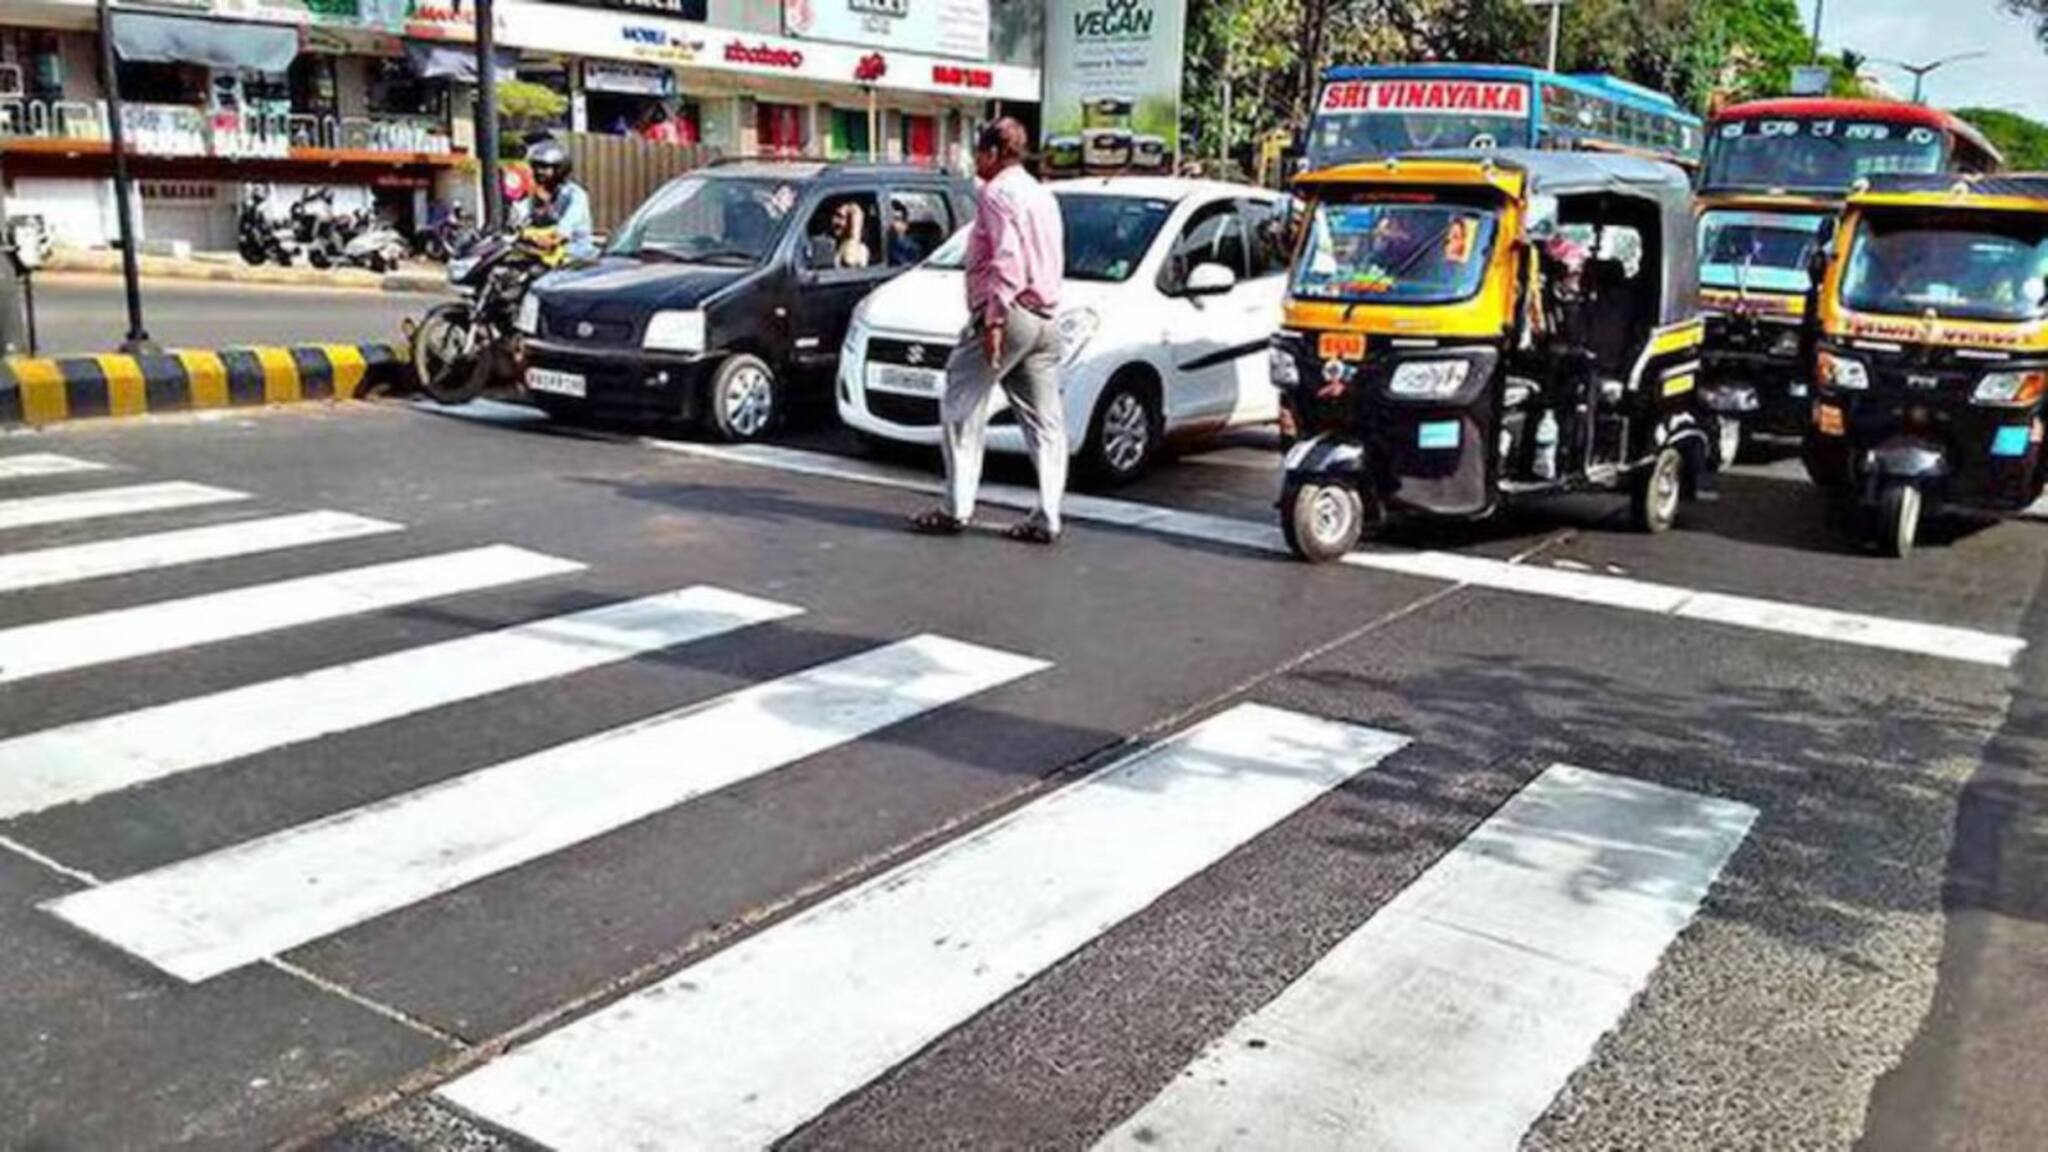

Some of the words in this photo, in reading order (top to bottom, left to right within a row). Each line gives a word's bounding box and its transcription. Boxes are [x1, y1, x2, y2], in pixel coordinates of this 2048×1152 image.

[1074, 9, 1154, 36] VEGAN
[1325, 83, 1369, 109] SRI
[1376, 83, 1523, 111] VINAYAKA
